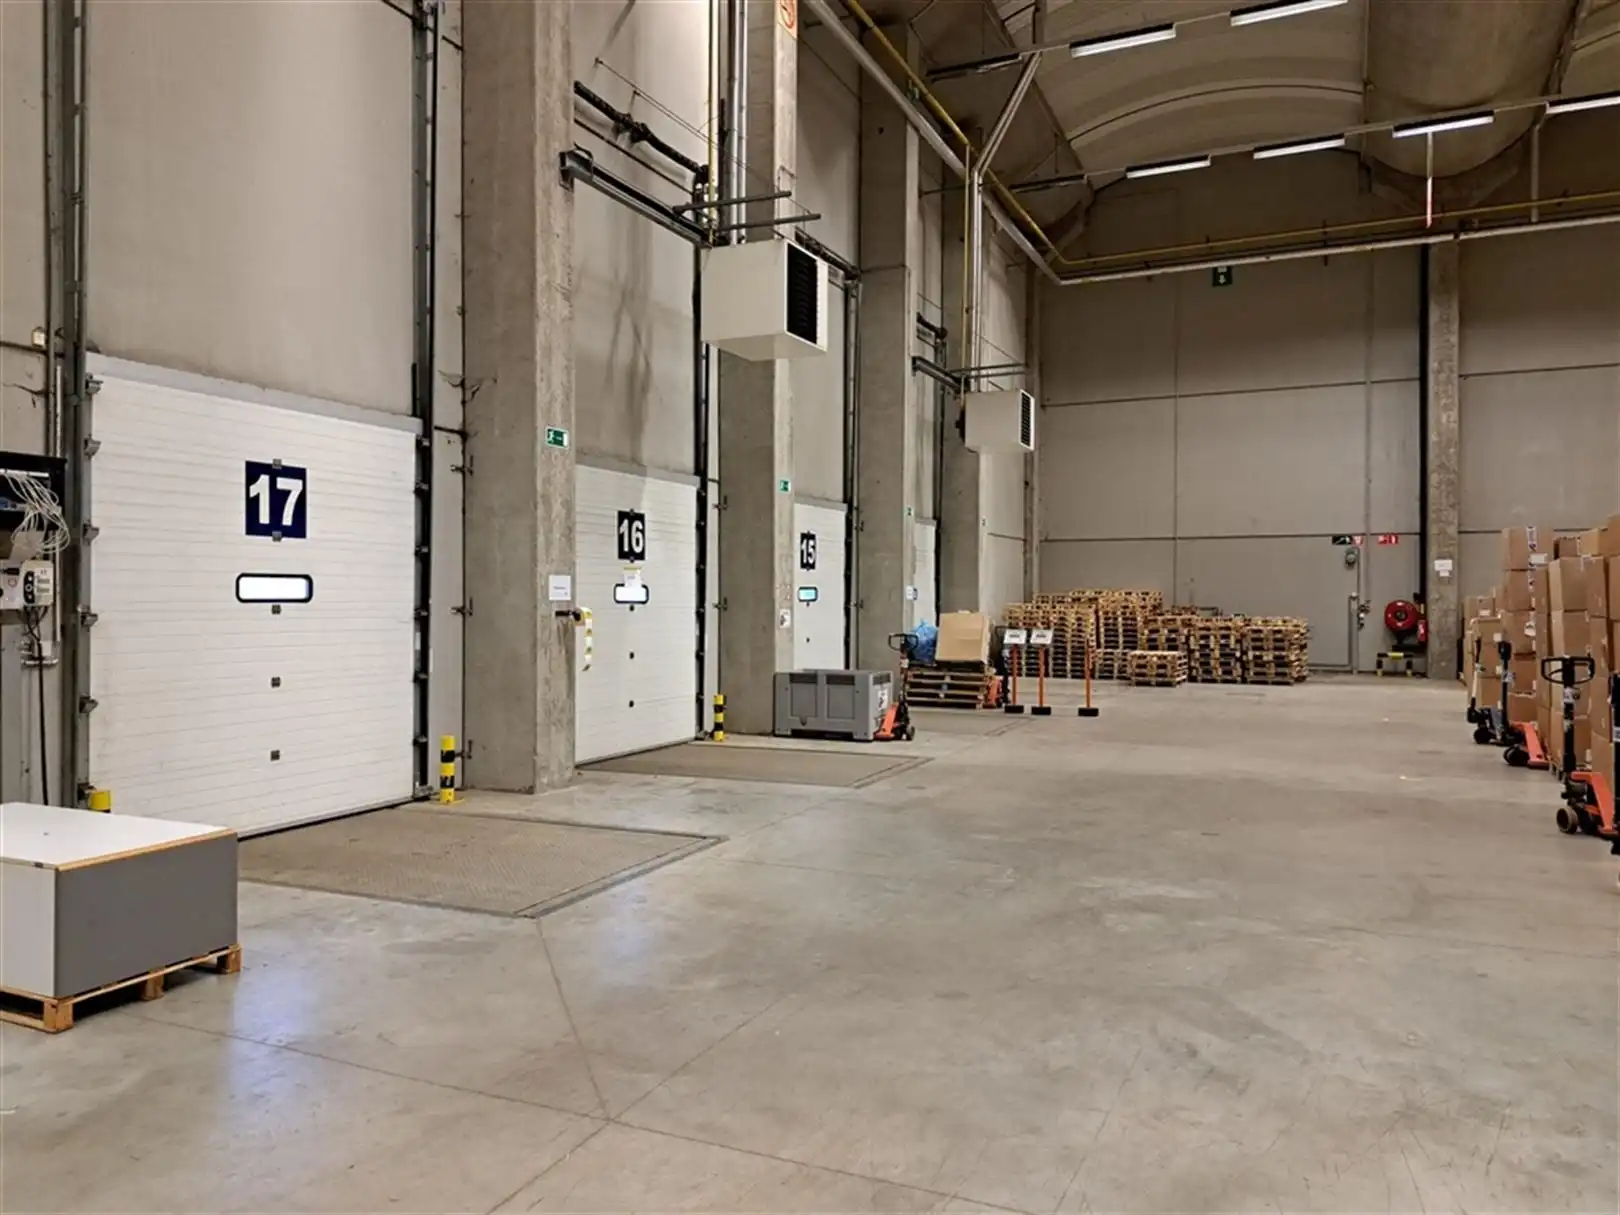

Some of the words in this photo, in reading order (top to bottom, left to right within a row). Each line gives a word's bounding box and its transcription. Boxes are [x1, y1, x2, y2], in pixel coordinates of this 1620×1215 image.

[249, 474, 303, 526] 17
[620, 518, 644, 553] 16
[801, 539, 816, 564] 15
